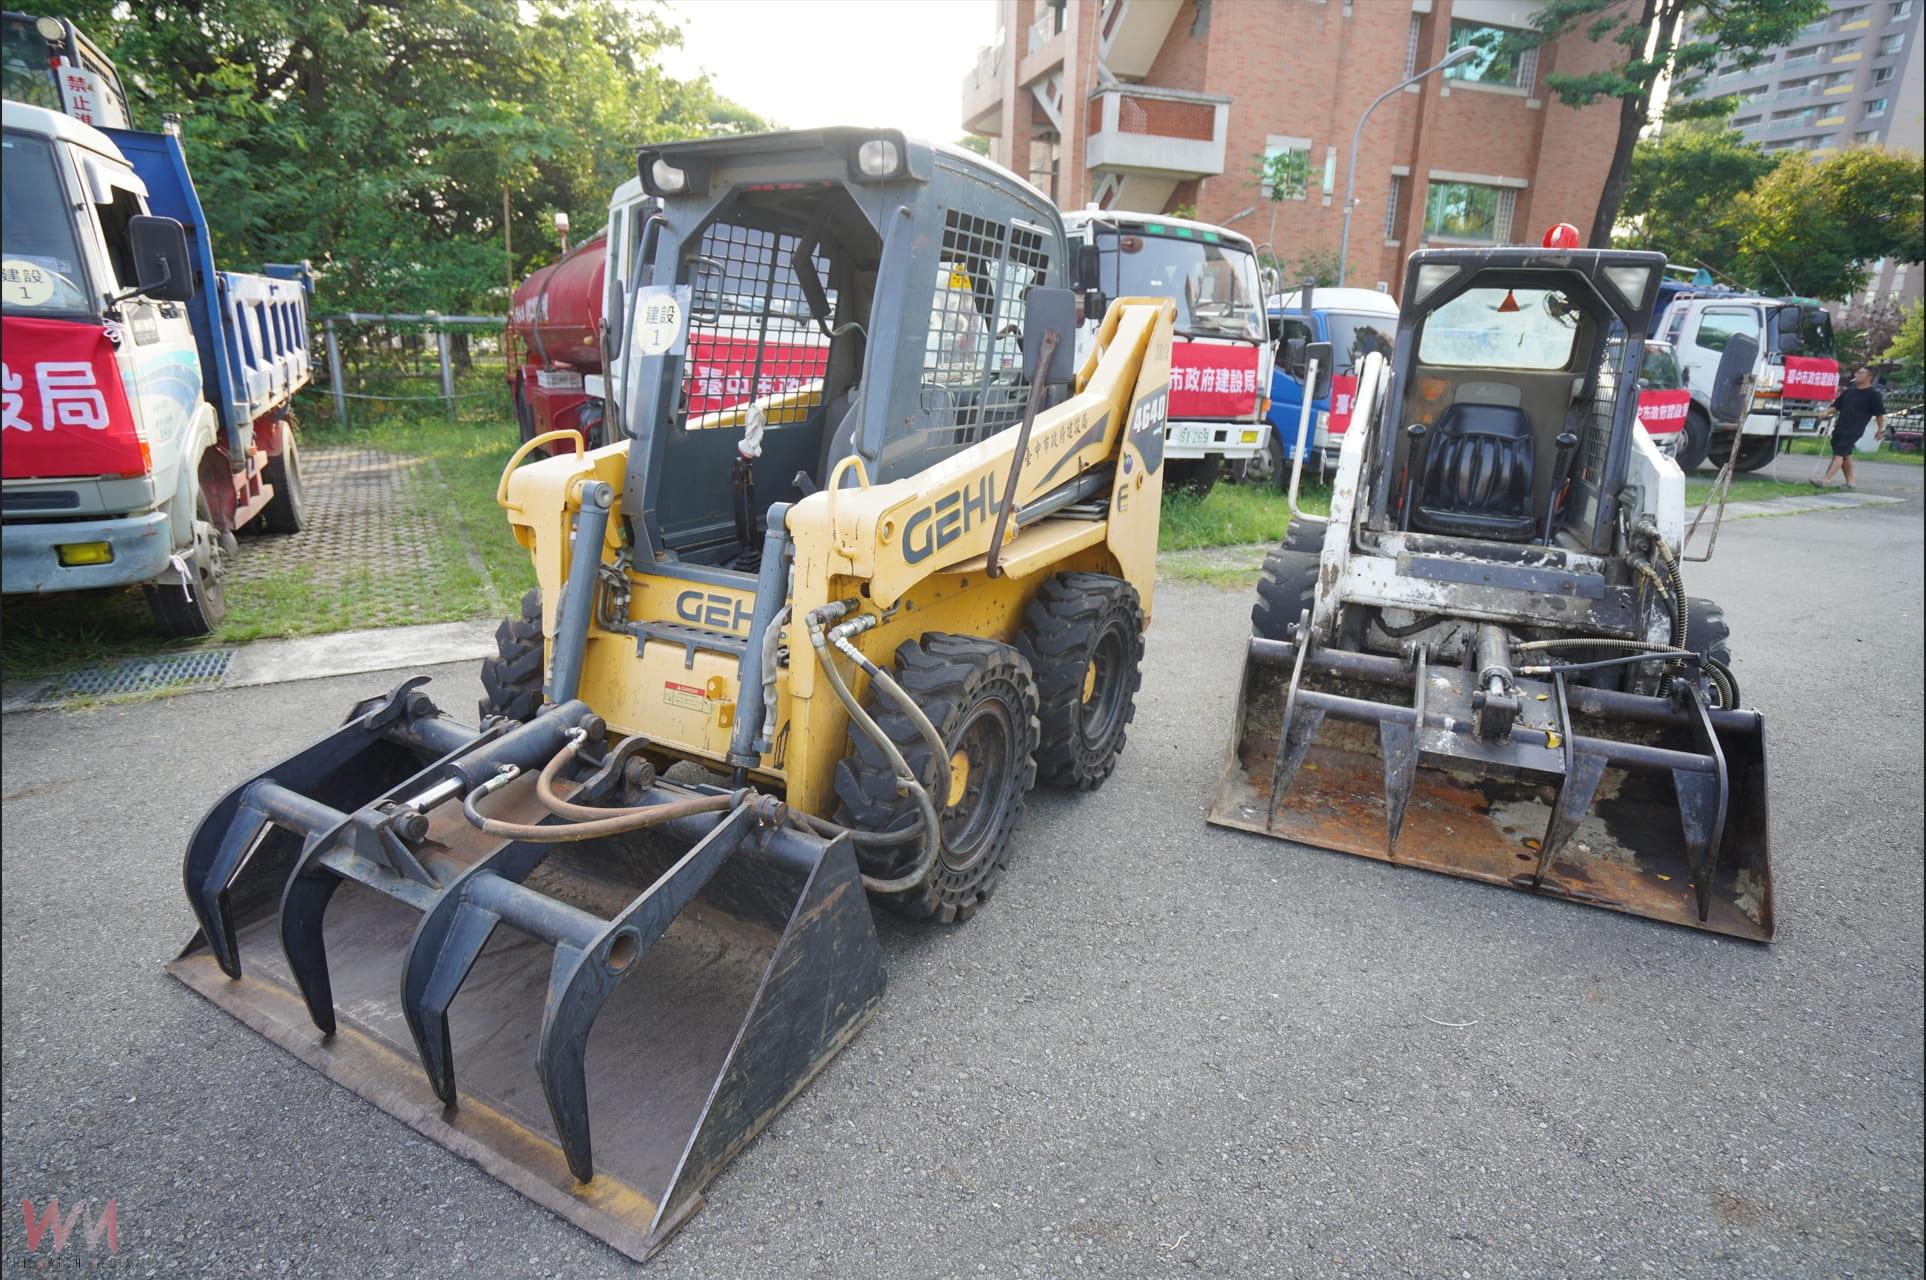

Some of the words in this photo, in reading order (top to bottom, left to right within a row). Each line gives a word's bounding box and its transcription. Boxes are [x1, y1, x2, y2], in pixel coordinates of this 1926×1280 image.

[19, 286, 31, 299] 1
[646, 305, 675, 324] 建設
[653, 330, 660, 346] 1
[1168, 366, 1256, 394] 市政府建設局
[1133, 394, 1166, 433] 4640
